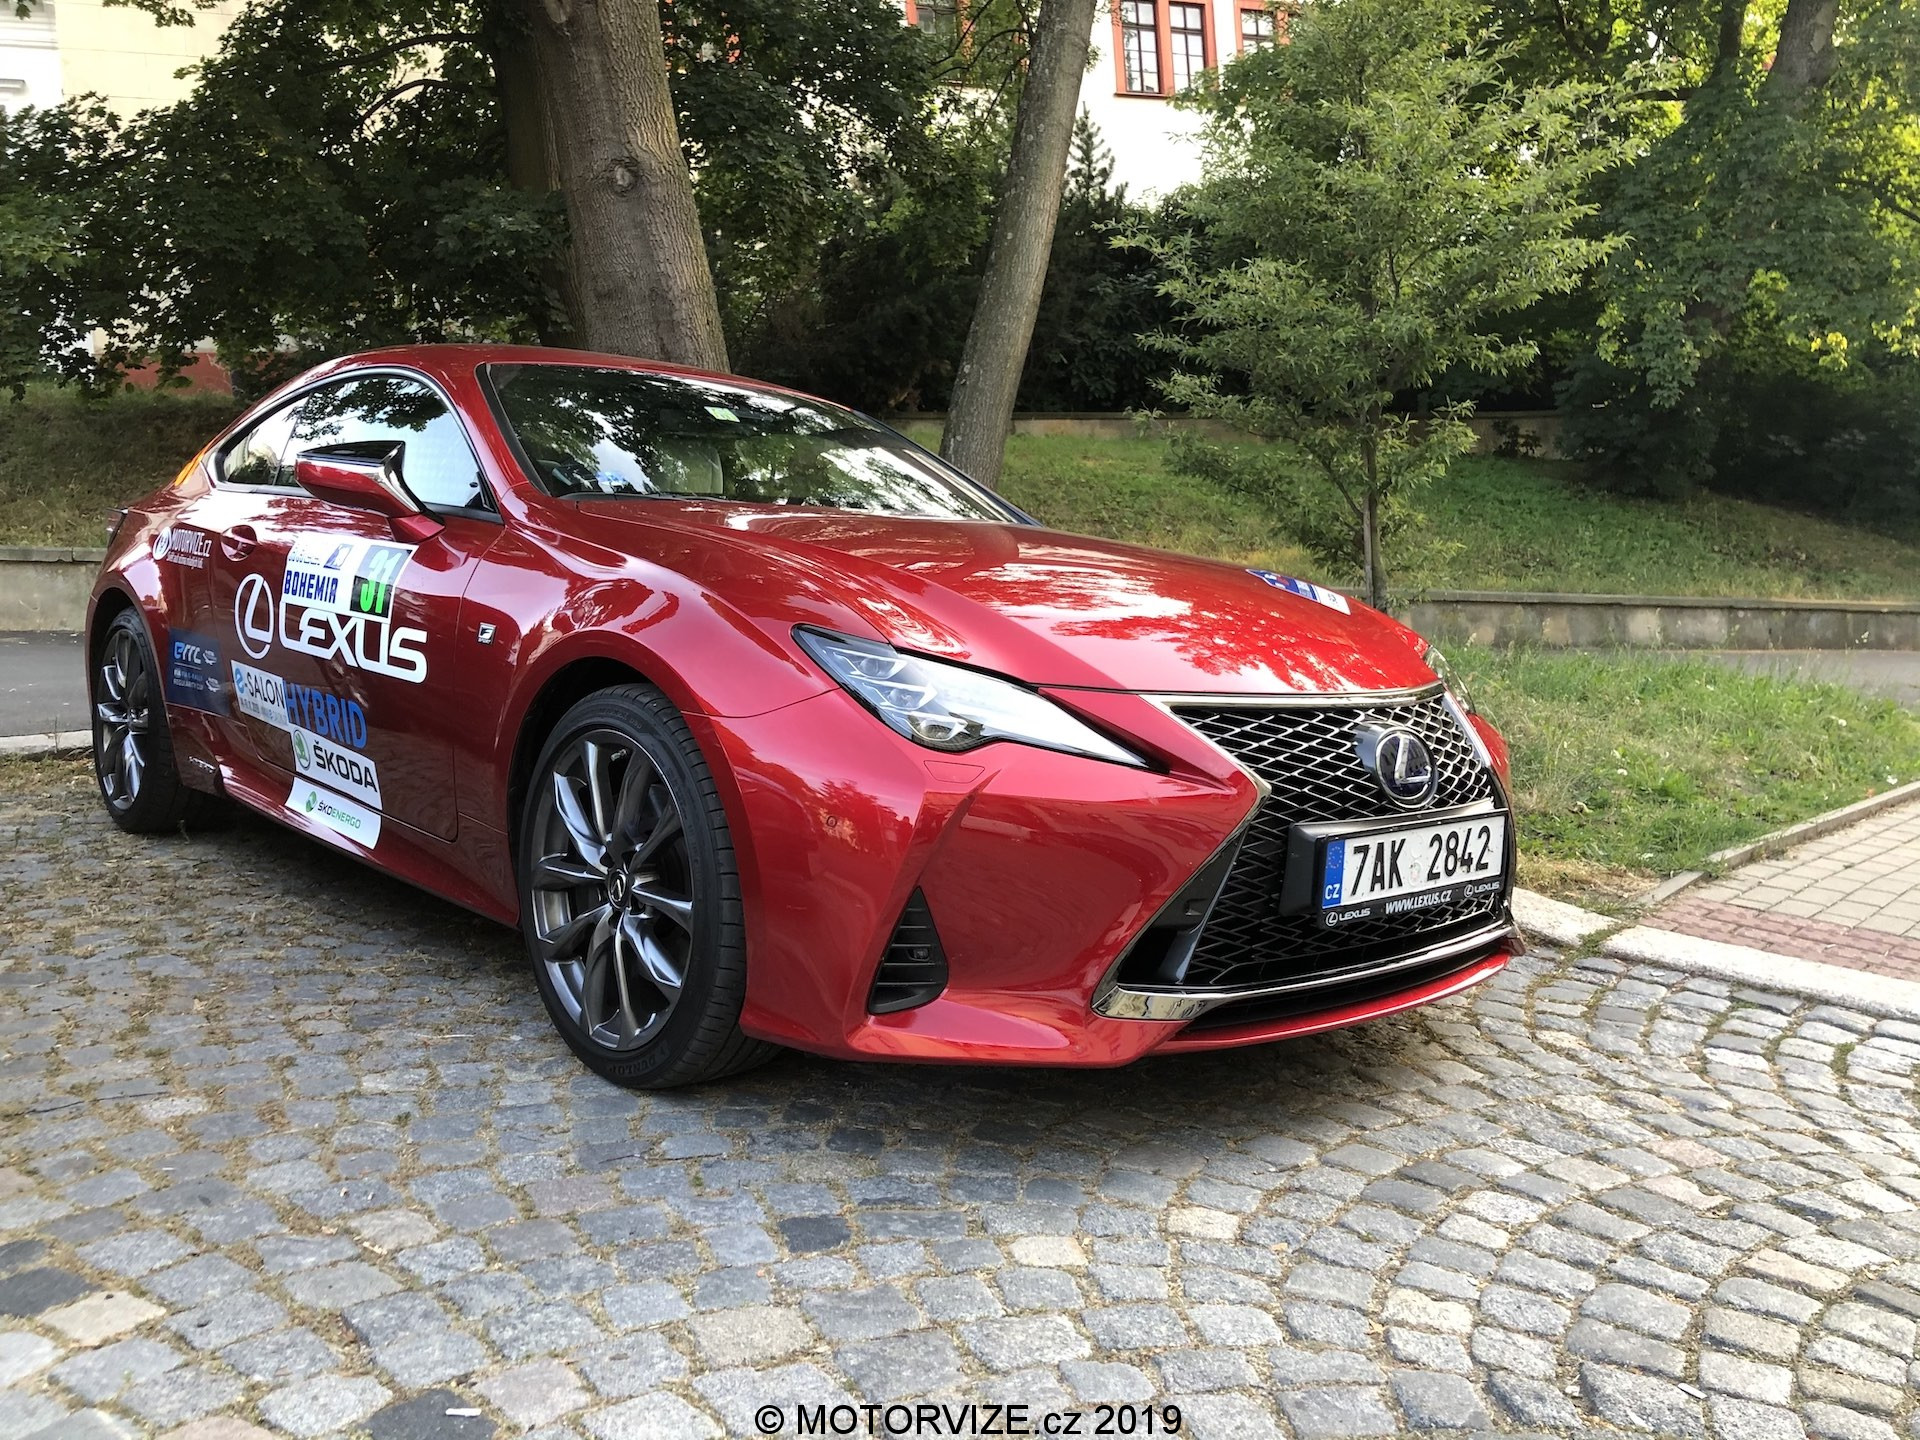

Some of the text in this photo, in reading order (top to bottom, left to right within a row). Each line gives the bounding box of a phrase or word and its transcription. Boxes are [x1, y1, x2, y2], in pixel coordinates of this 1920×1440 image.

[283, 570, 339, 604] BOHEMIA
[359, 549, 402, 614] 31
[279, 602, 428, 683] LEXUS
[283, 680, 368, 750] HYBRID
[312, 739, 378, 793] ŠKODA
[317, 800, 361, 829] ŠKOENERGO
[1350, 825, 1492, 897] 7AK 2842
[1325, 882, 1340, 900] CZ
[1338, 881, 1500, 921] LEXUS WWW.LEXUS.CZ LEXUS
